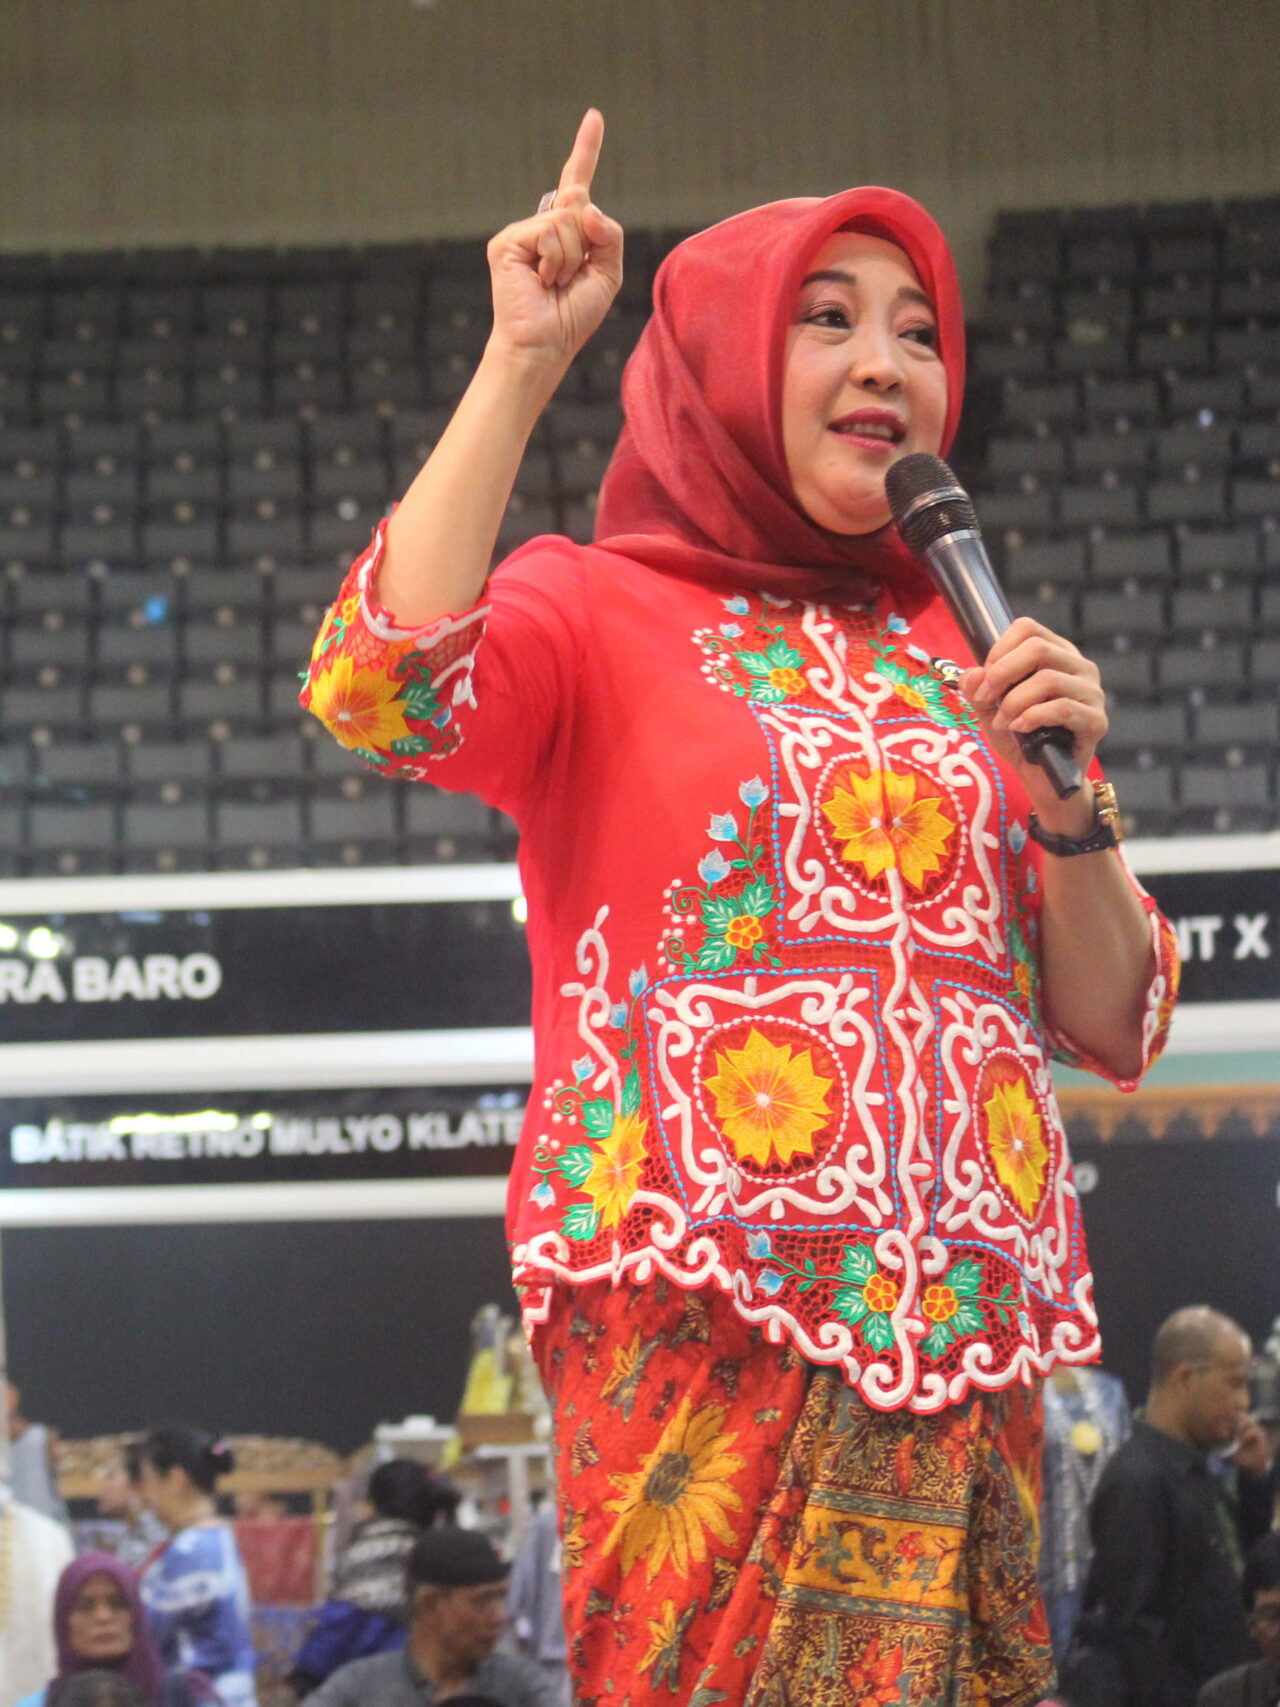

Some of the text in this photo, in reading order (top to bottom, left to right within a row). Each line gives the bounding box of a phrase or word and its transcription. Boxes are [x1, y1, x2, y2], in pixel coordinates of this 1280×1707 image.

[1175, 912, 1272, 961] IT X
[73, 954, 222, 1002] BARO
[269, 1114, 402, 1157] MULYO
